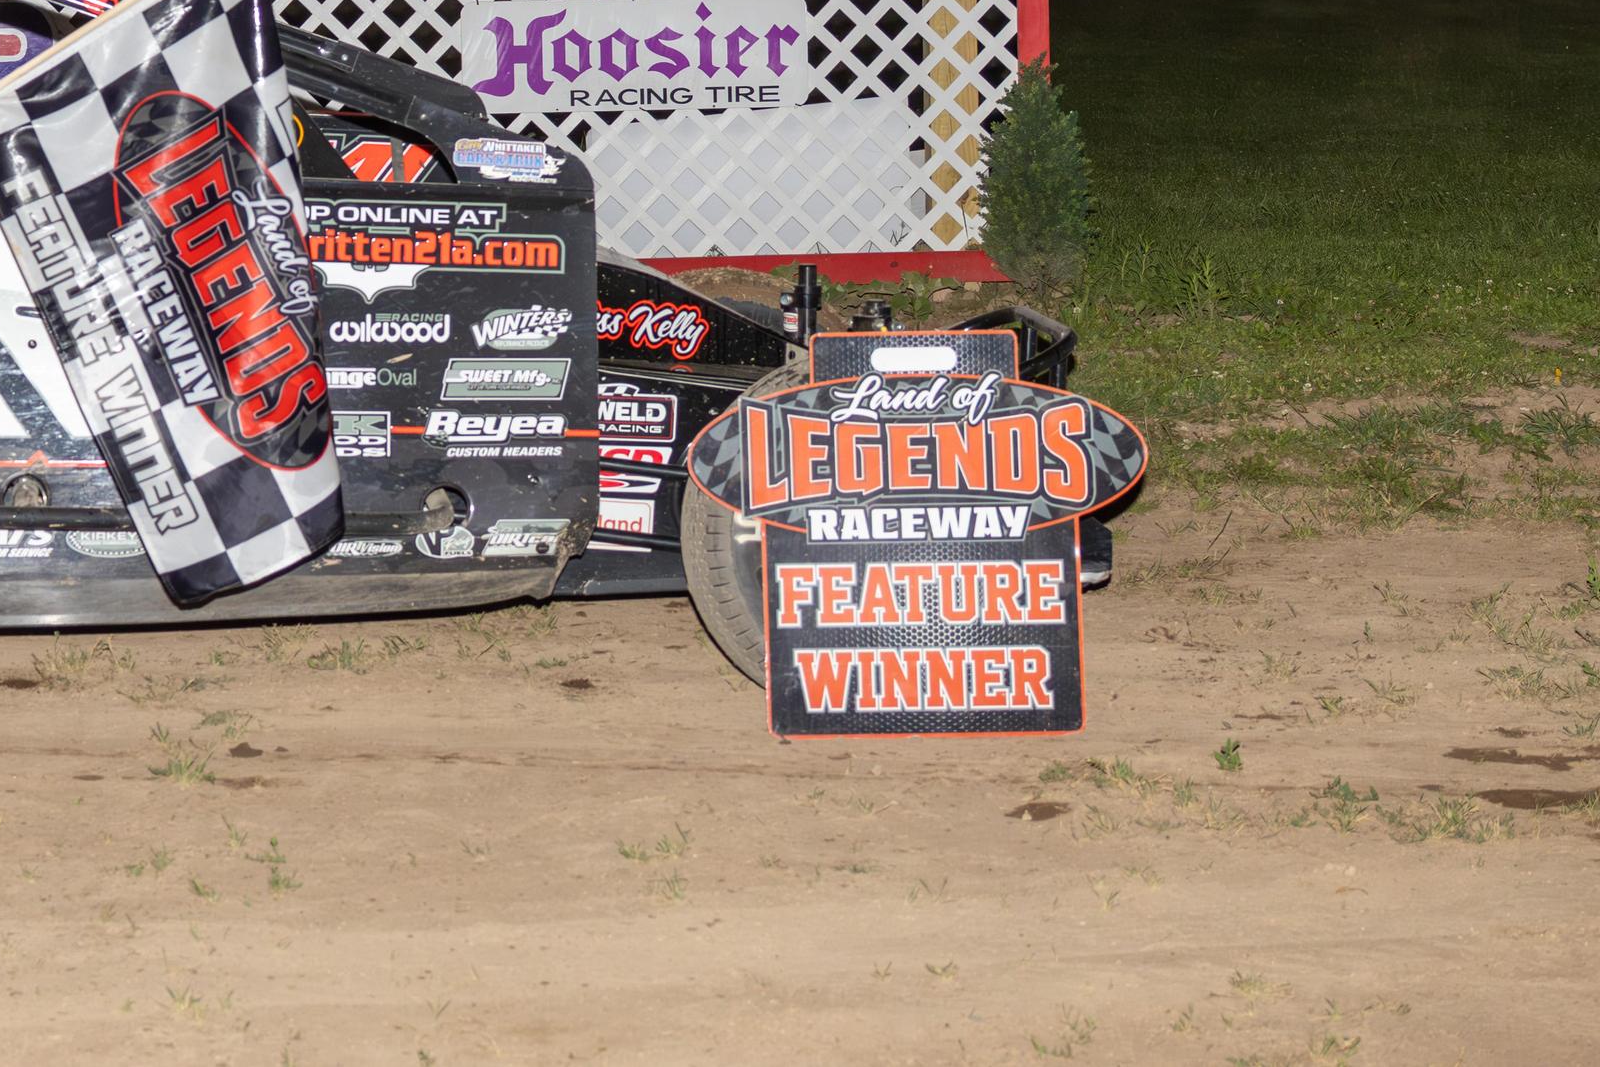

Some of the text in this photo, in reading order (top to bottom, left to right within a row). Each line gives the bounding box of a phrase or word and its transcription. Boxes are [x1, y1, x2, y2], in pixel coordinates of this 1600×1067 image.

[472, 1, 801, 97] Hoosier
[569, 85, 781, 107] RACING TIRE
[232, 176, 312, 277] Land
[338, 206, 450, 225] ONLINE
[457, 209, 498, 226] AT
[309, 228, 559, 268] ritten21a.com
[122, 116, 329, 441] LEGENDS
[111, 219, 220, 408] RACEWAY
[330, 314, 450, 343] wilwood
[392, 313, 444, 323] RACING
[471, 309, 572, 349] WINTERS
[629, 305, 705, 354] Kelly
[4, 168, 199, 536] FEATURE WINNER
[450, 369, 512, 383] SWEET
[831, 371, 1001, 426] Land of
[427, 411, 566, 442] Beyea
[446, 446, 563, 457] CUSTOM HEADERS
[746, 401, 1088, 511] LEGENDS
[80, 532, 137, 542] KIRKEY
[807, 505, 1030, 542] RACEWAY
[8, 547, 54, 558] SERVICE
[776, 559, 1066, 629] FEATURE
[793, 646, 1055, 713] WINNER
